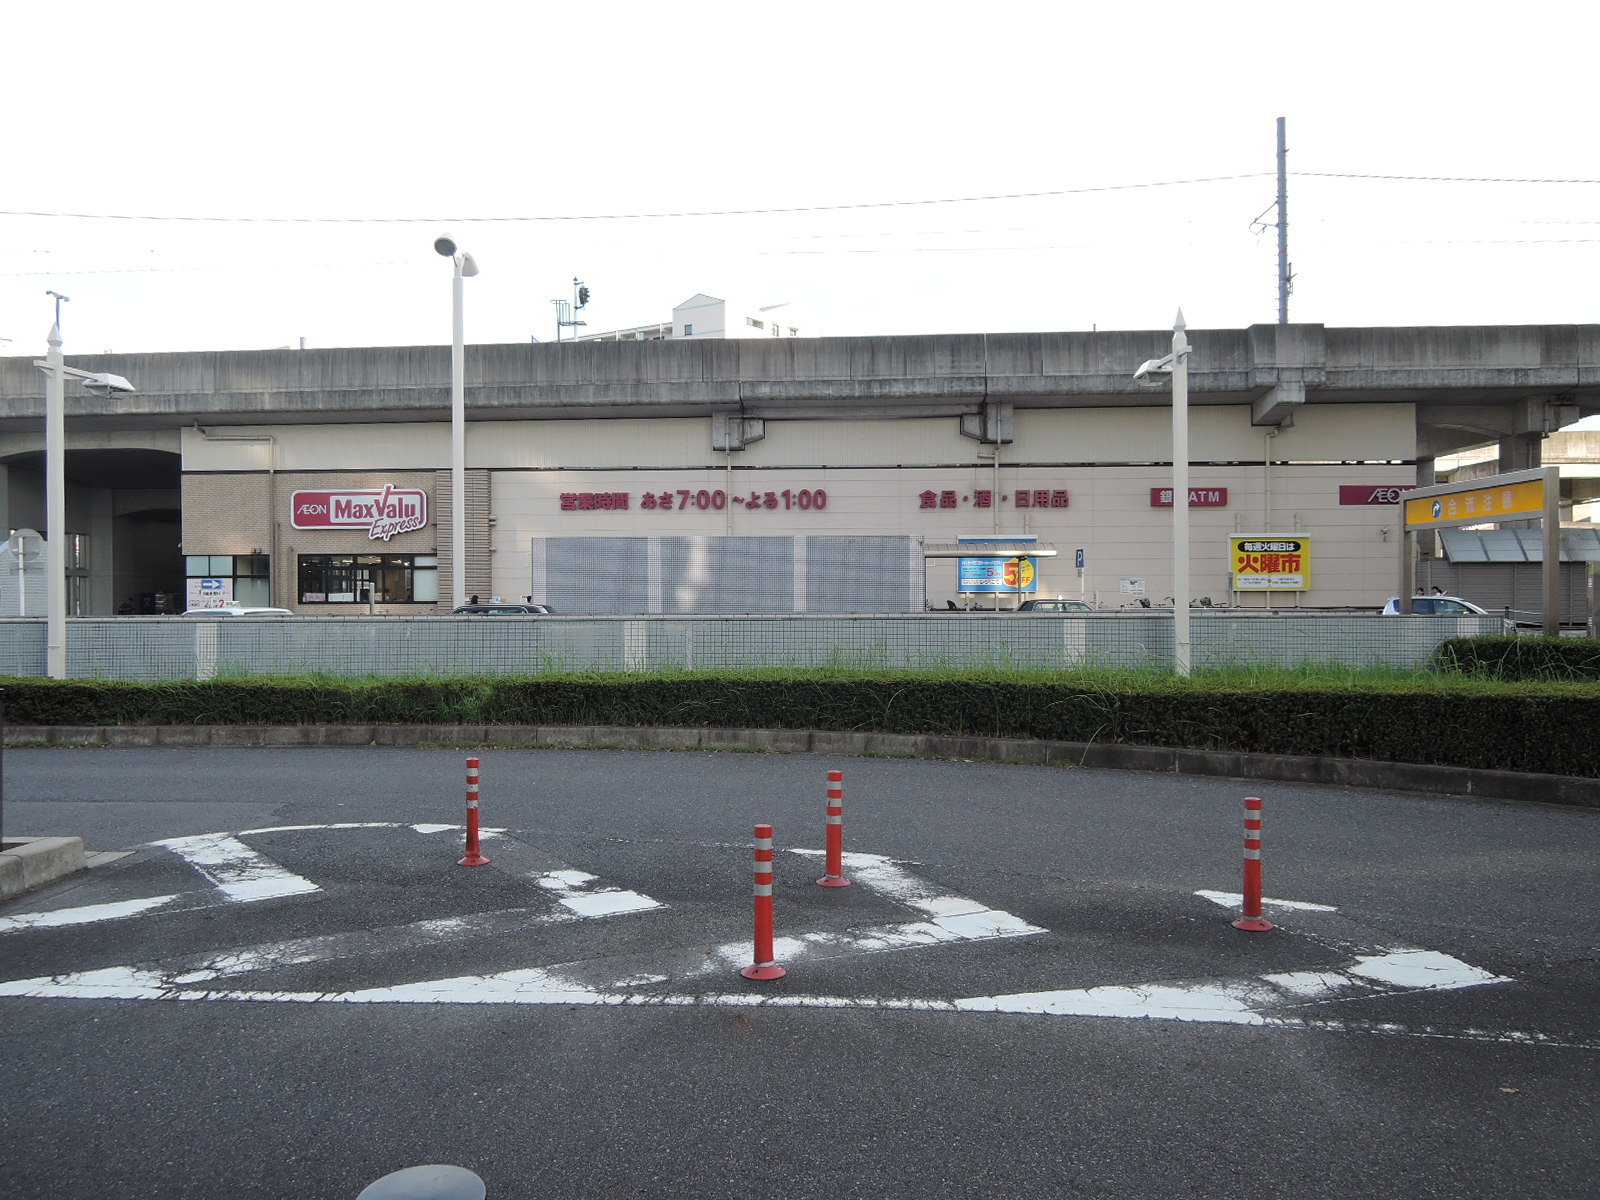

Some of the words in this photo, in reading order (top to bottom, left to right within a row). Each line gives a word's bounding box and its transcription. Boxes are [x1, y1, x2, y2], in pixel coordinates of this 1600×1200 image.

[335, 485, 416, 519] MaxValu
[559, 491, 629, 511] 営業時間
[1368, 488, 1412, 503] AEO
[371, 516, 420, 537] Express
[1077, 551, 1083, 566] P
[1238, 553, 1302, 573] 火曜市
